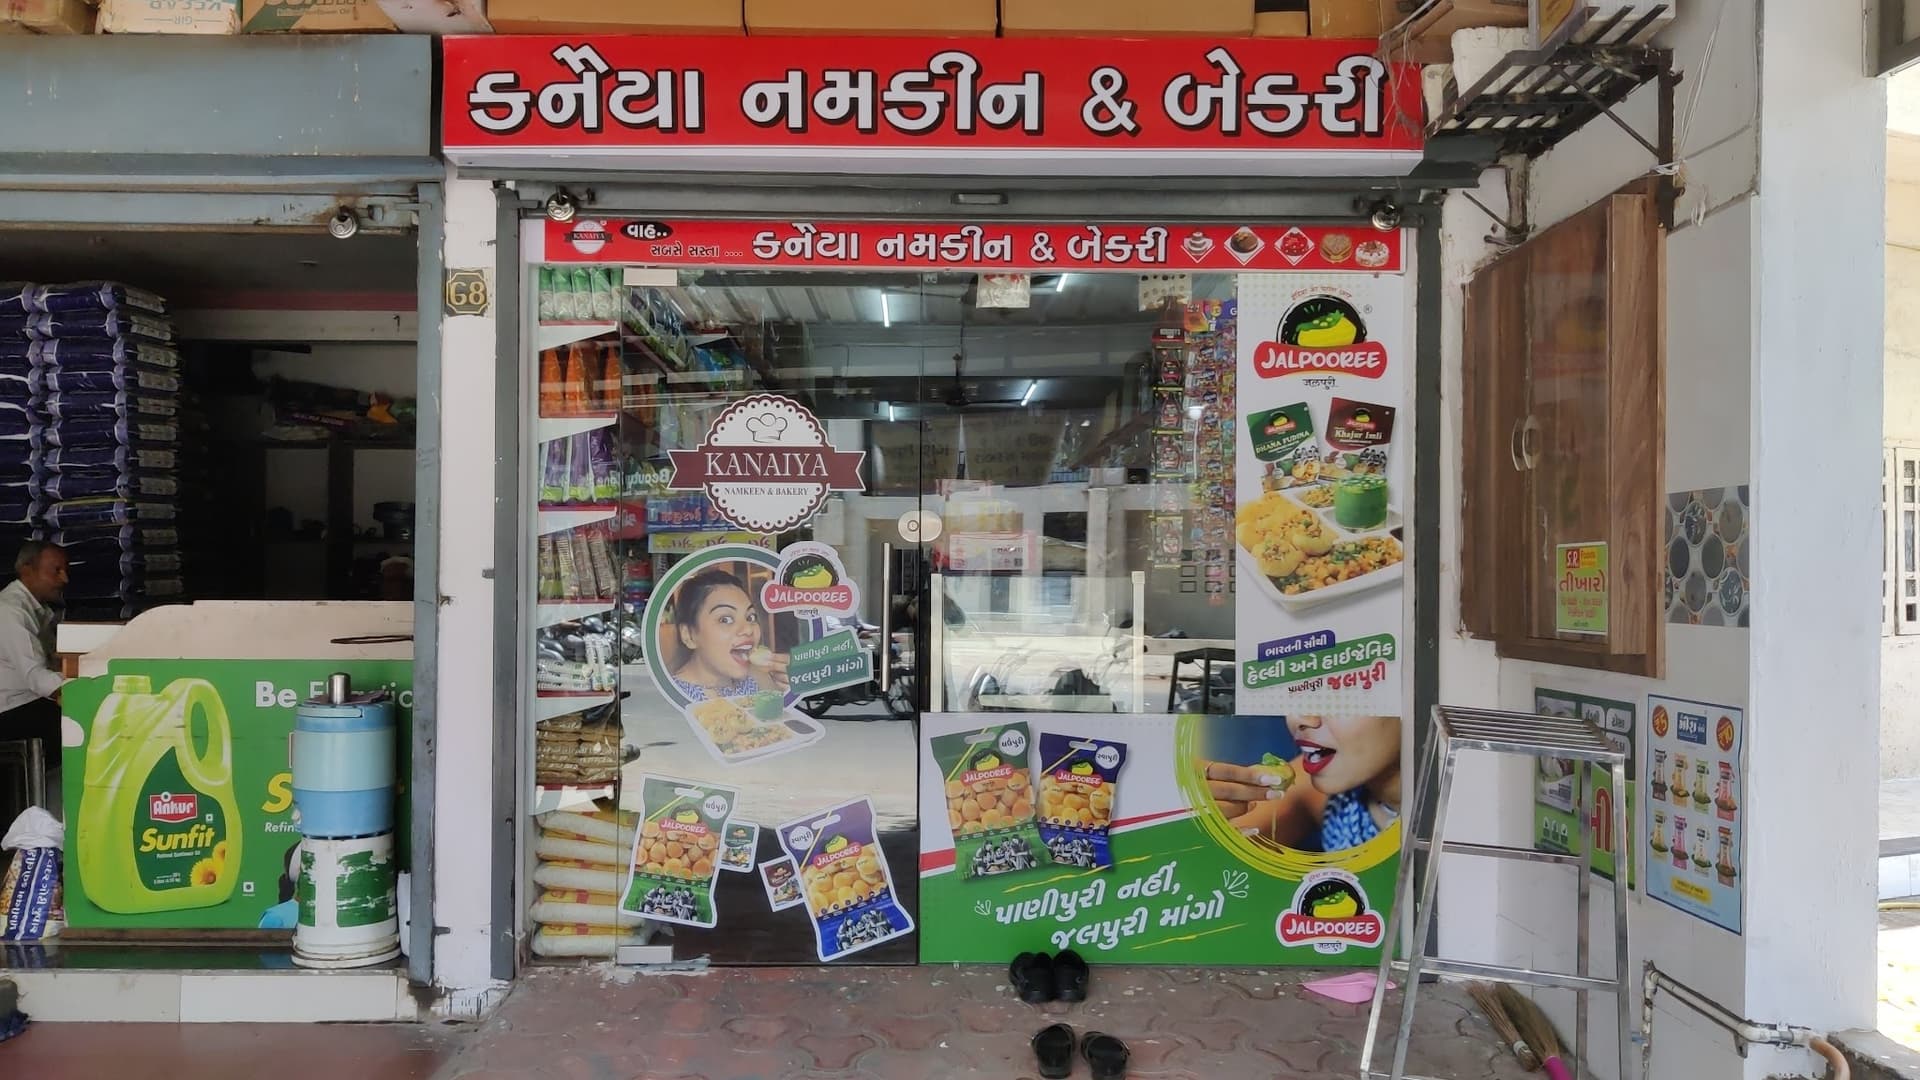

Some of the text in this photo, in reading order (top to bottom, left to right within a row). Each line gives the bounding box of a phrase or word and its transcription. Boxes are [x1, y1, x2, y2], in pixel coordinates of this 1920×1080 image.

[174, 16, 193, 25] GIR
[468, 44, 1387, 136] કનૈયા નમકીન & બેકરી
[651, 241, 683, 257] સબસે
[753, 222, 1168, 263] કનૈયા નમકીન & બેકરી
[450, 281, 485, 306] 68
[1261, 348, 1381, 369] JALPOOREE
[704, 453, 829, 476] KANAIYA
[725, 487, 809, 496] NAMKEEN & BAKERY
[769, 589, 848, 603] JALPOOREE
[1265, 639, 1302, 656] ભારતની
[790, 657, 863, 685] જલપુરી માંગો
[1289, 654, 1317, 673] અને
[1327, 662, 1385, 690] જલપુરી
[255, 681, 297, 708] Be
[964, 768, 1013, 783] JALPOOREE
[1057, 772, 1101, 785] JALPOOREE
[153, 801, 194, 815] Ankur
[265, 822, 295, 833] Refin
[661, 820, 706, 834] JALPOOREE
[139, 824, 215, 852] Sunfit
[817, 845, 859, 866] JALPOOREE
[995, 879, 1106, 924] પાણીપુરી
[1050, 890, 1225, 950] જલપુરી માંગો
[1286, 918, 1376, 935] JALPOOREE
